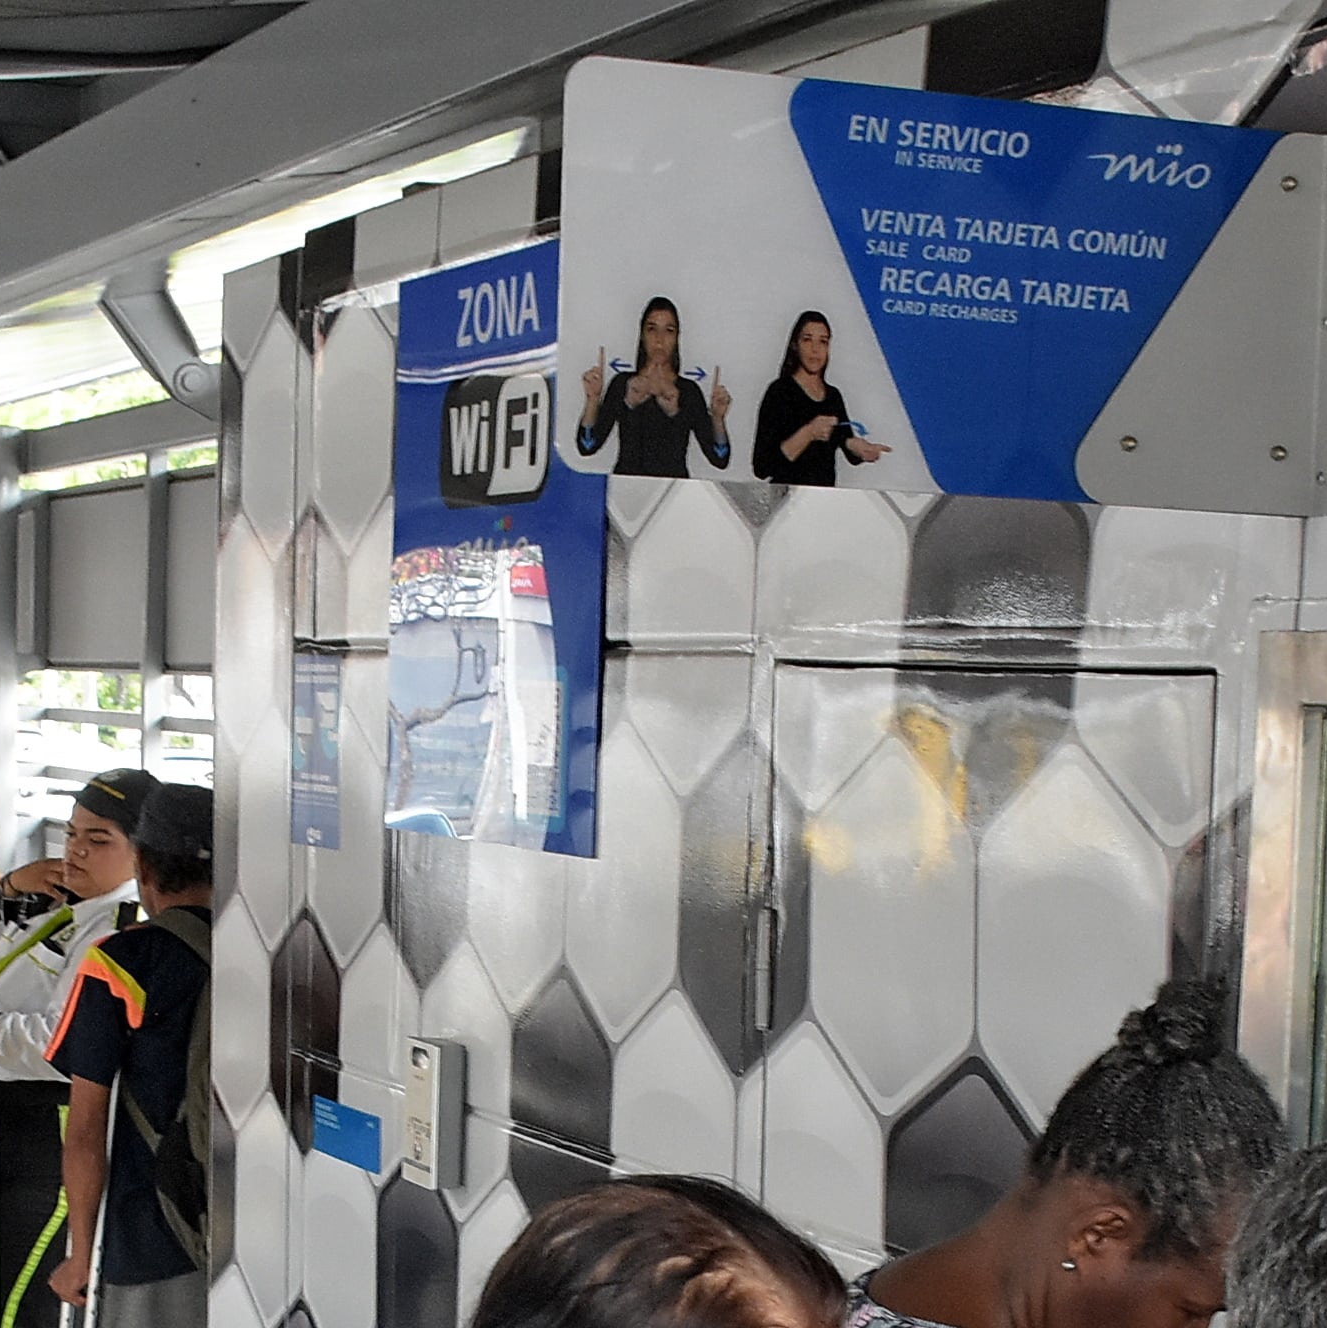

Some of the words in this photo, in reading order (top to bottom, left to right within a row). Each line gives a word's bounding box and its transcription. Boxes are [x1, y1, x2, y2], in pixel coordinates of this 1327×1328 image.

[848, 114, 890, 144] EN
[897, 120, 1031, 159] SERVICIO
[895, 151, 914, 166] IN
[918, 153, 983, 173] SERVICE
[861, 208, 946, 239] VENTA
[955, 217, 1060, 250] TARJETA
[1068, 229, 1168, 260] COMÚN
[865, 239, 909, 258] SALE
[922, 244, 972, 264] CARD
[456, 271, 541, 347] ZONA
[879, 267, 1012, 303] RECARGA
[1020, 279, 1131, 313] TARJETA
[882, 299, 925, 316] CARD
[928, 304, 1018, 324] RECHARGES
